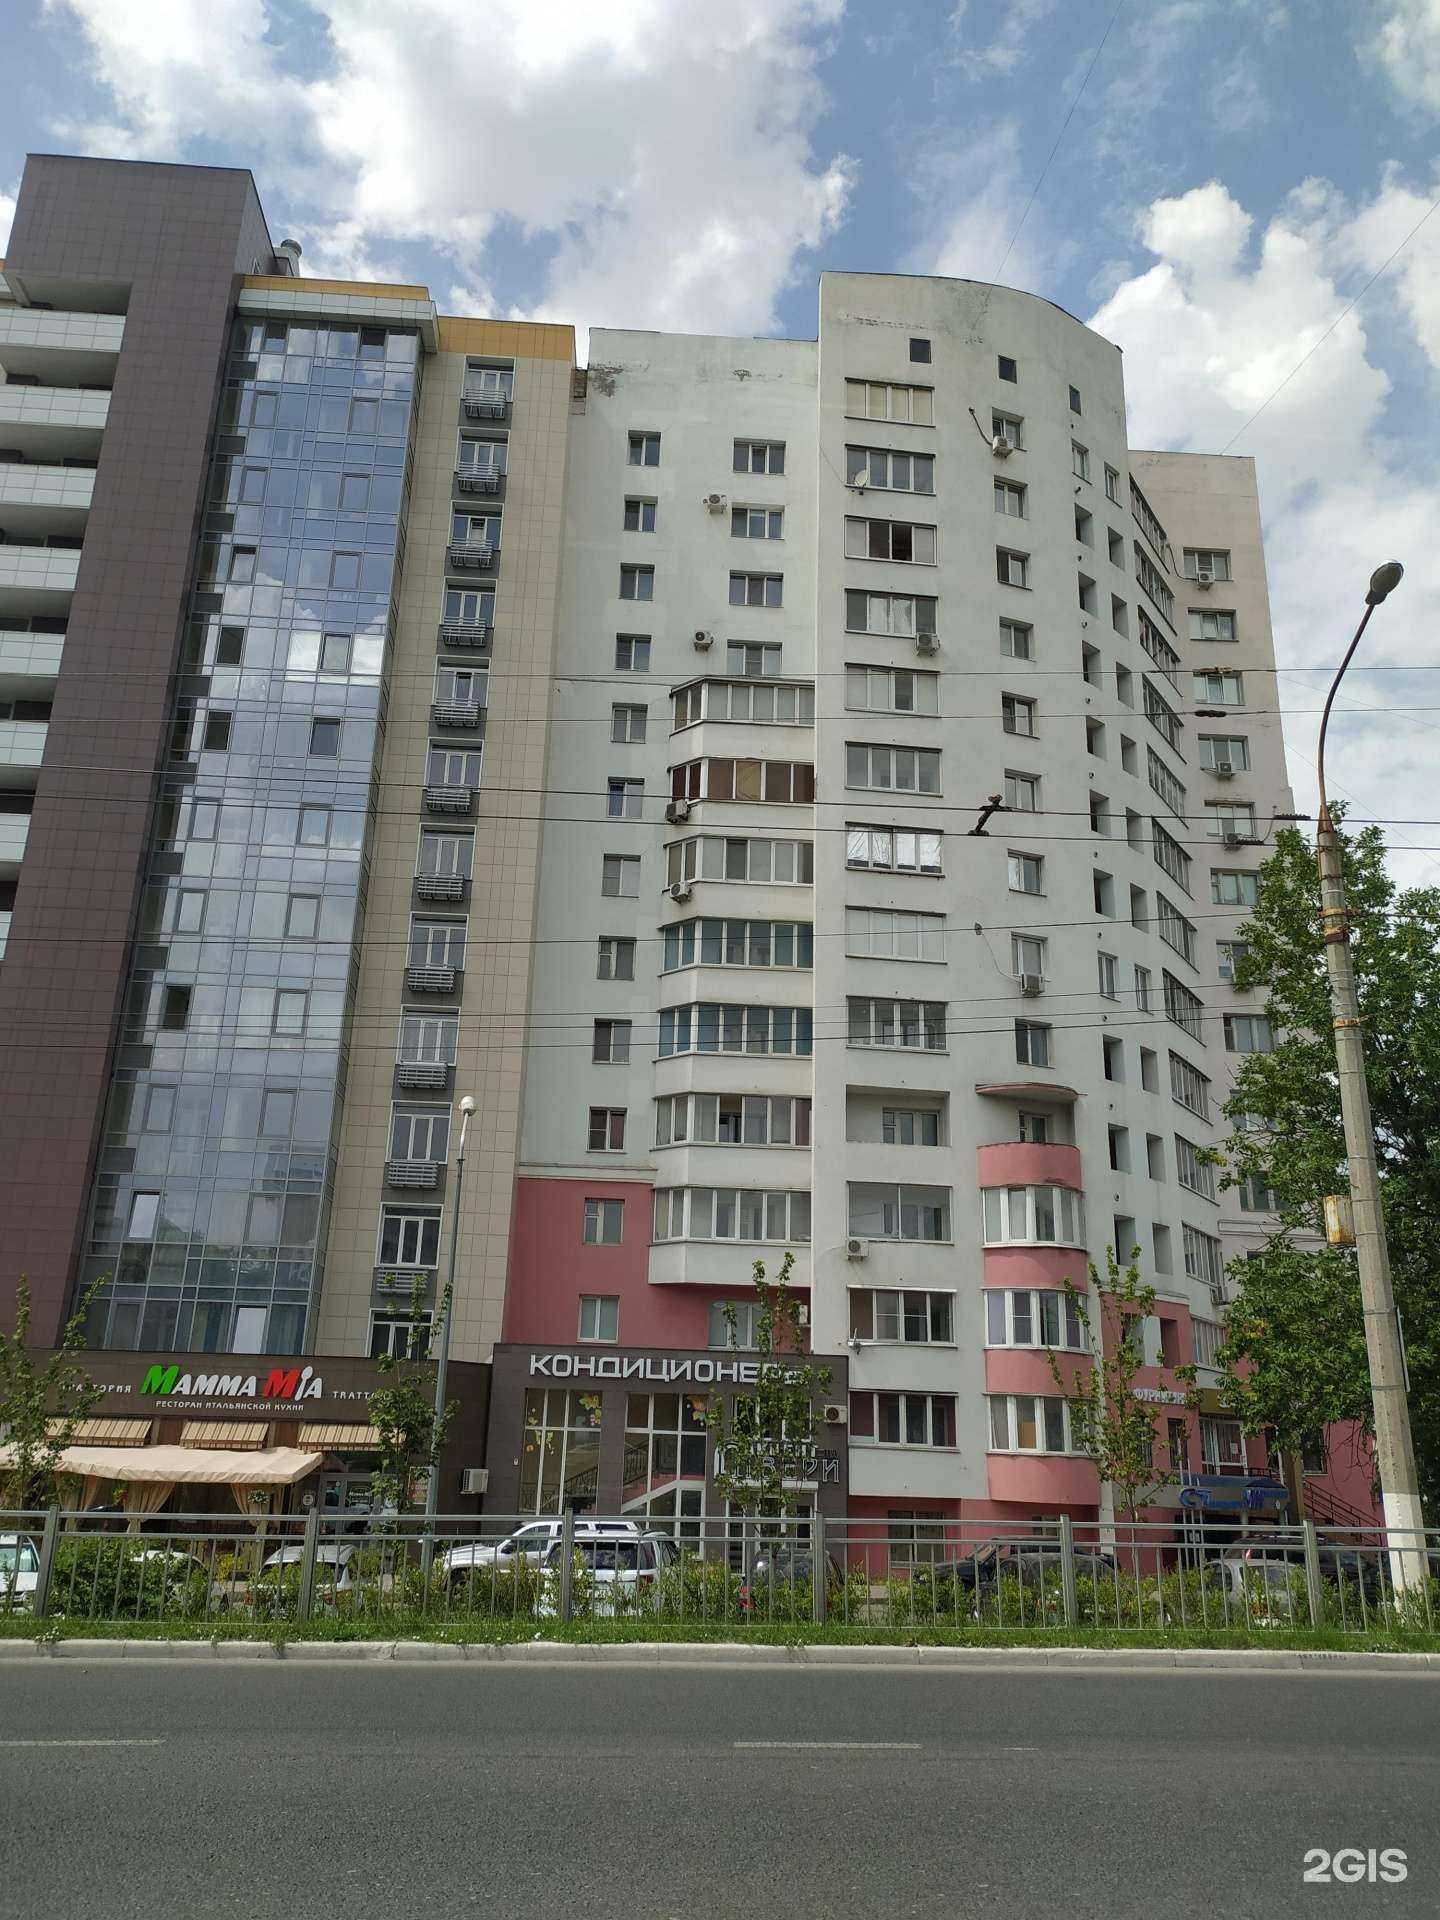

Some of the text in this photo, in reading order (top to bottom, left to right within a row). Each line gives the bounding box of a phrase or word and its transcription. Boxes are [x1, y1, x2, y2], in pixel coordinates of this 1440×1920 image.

[155, 1400, 305, 1412] РЕСТОРАН ИТАЛЬЯНСКОЙ КУХНИ
